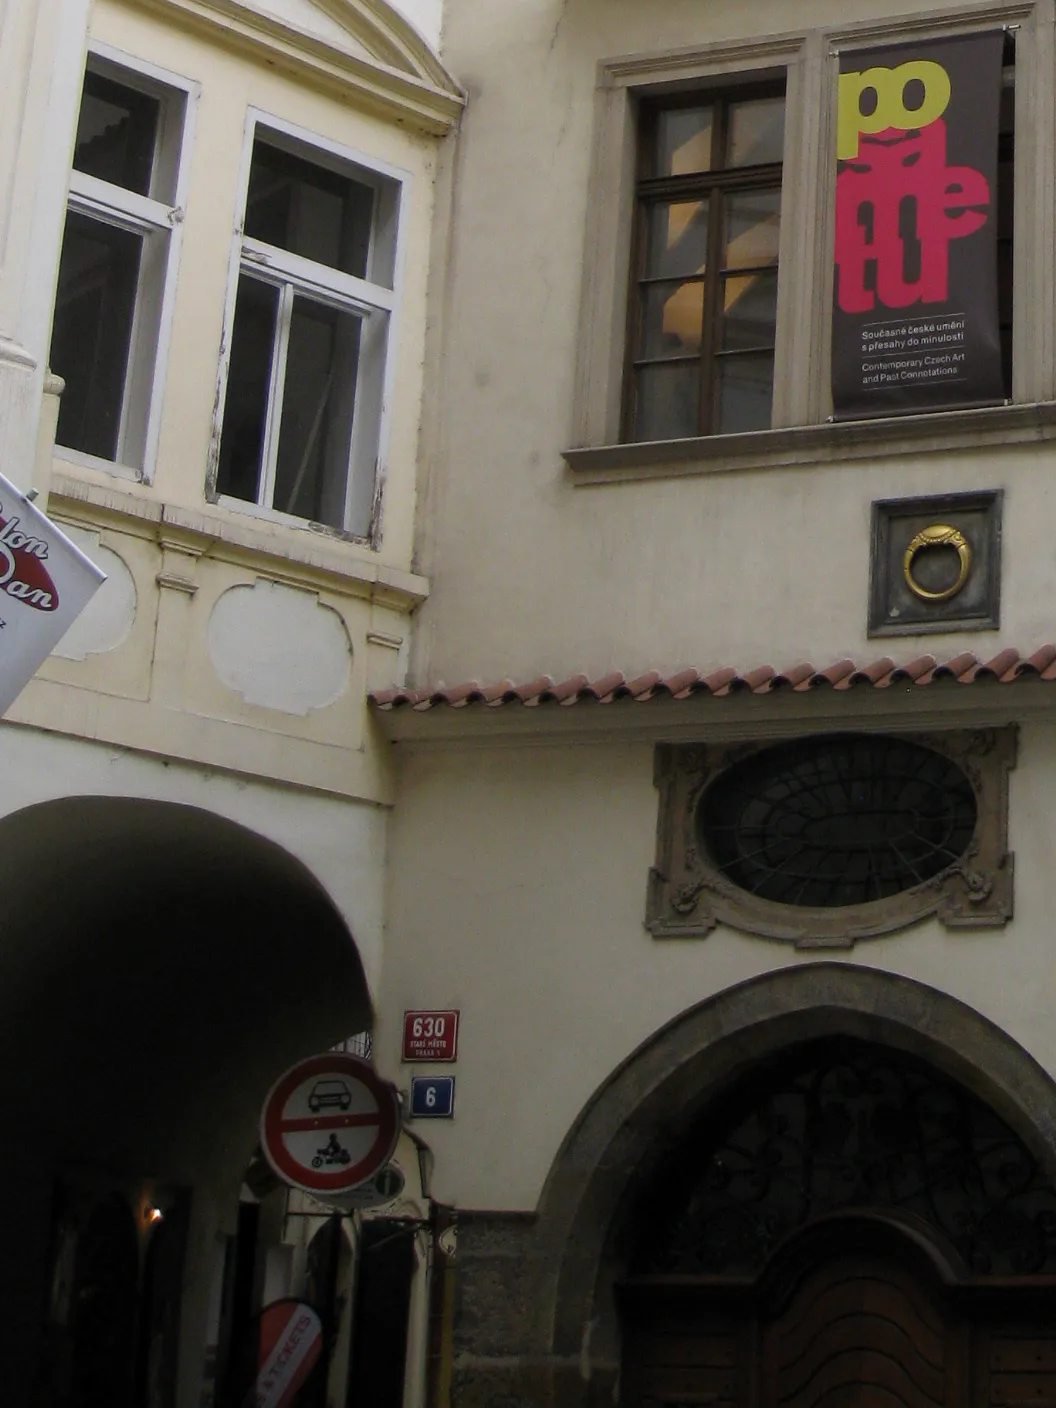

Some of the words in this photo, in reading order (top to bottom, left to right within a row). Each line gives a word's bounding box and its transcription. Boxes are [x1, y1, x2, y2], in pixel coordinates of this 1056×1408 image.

[861, 327, 907, 340] Současné
[907, 323, 935, 335] české
[936, 320, 965, 331] umění
[861, 344, 867, 352] s
[868, 339, 906, 352] přesahy
[907, 337, 919, 347] do
[920, 332, 964, 345] minulosti
[862, 358, 923, 372] Contemporary
[924, 355, 951, 365] Czech
[952, 353, 965, 361] Art
[862, 375, 879, 384] and
[880, 372, 899, 382] Past
[900, 367, 958, 379] Connotations
[413, 1017, 445, 1037] 630
[425, 1086, 436, 1107] 6
